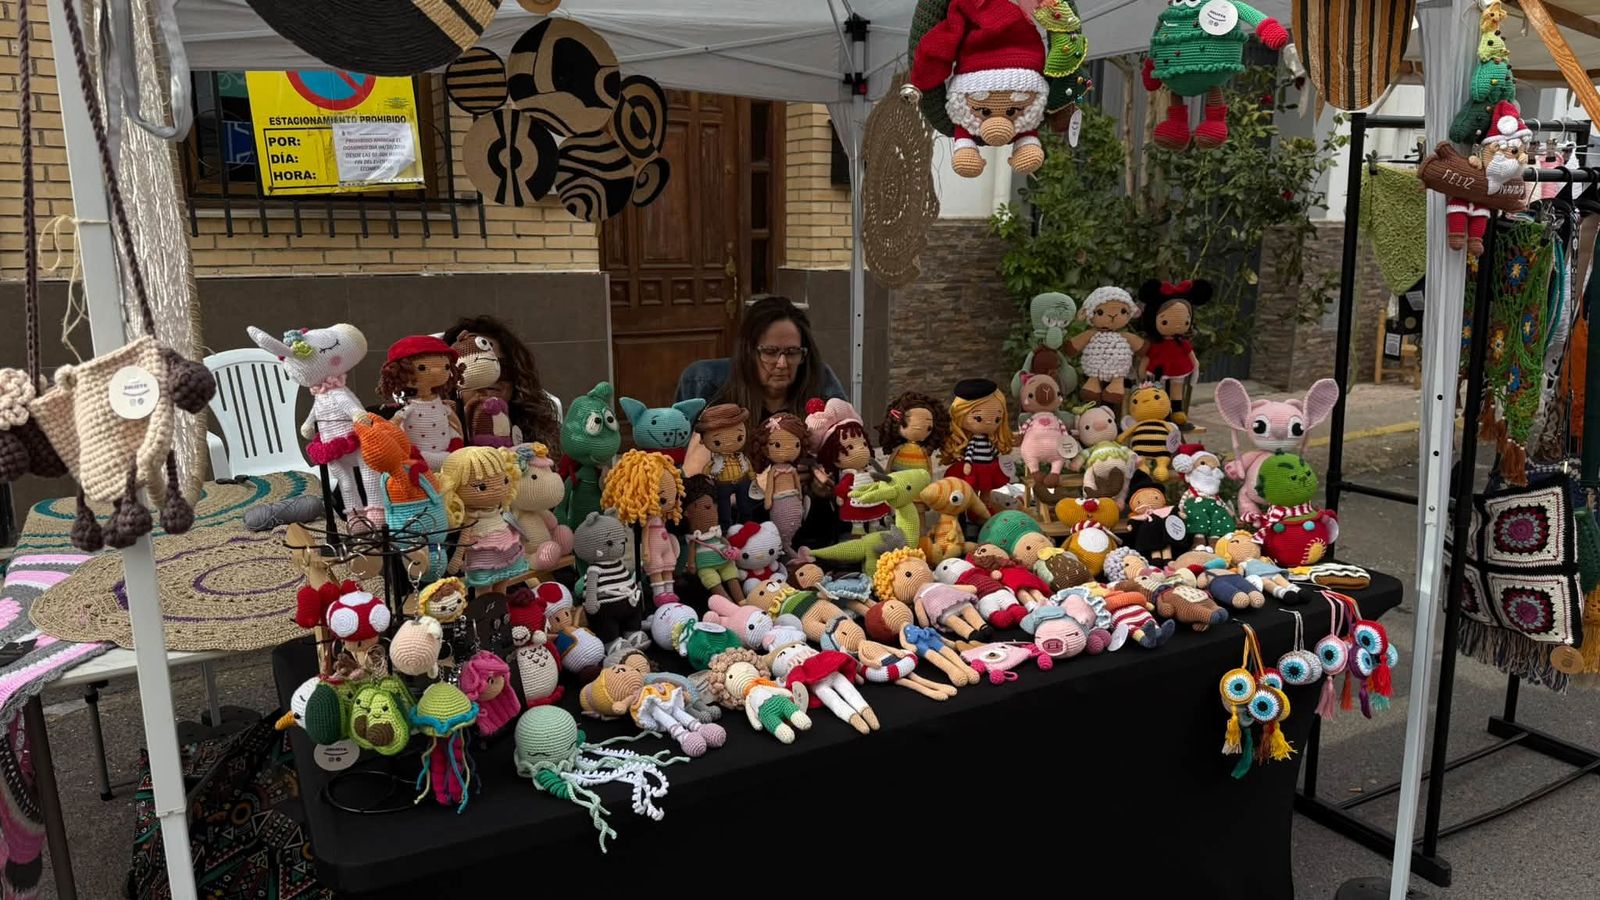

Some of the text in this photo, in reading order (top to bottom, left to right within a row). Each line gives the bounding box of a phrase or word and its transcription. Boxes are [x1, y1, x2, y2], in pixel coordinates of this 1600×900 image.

[269, 115, 407, 125] ESTACIONAMIENTO PROHIBIDO
[268, 137, 301, 147] POR:
[271, 151, 299, 164] DÍA:
[273, 171, 317, 181] HORA:
[1442, 169, 1475, 190] FELIZ
